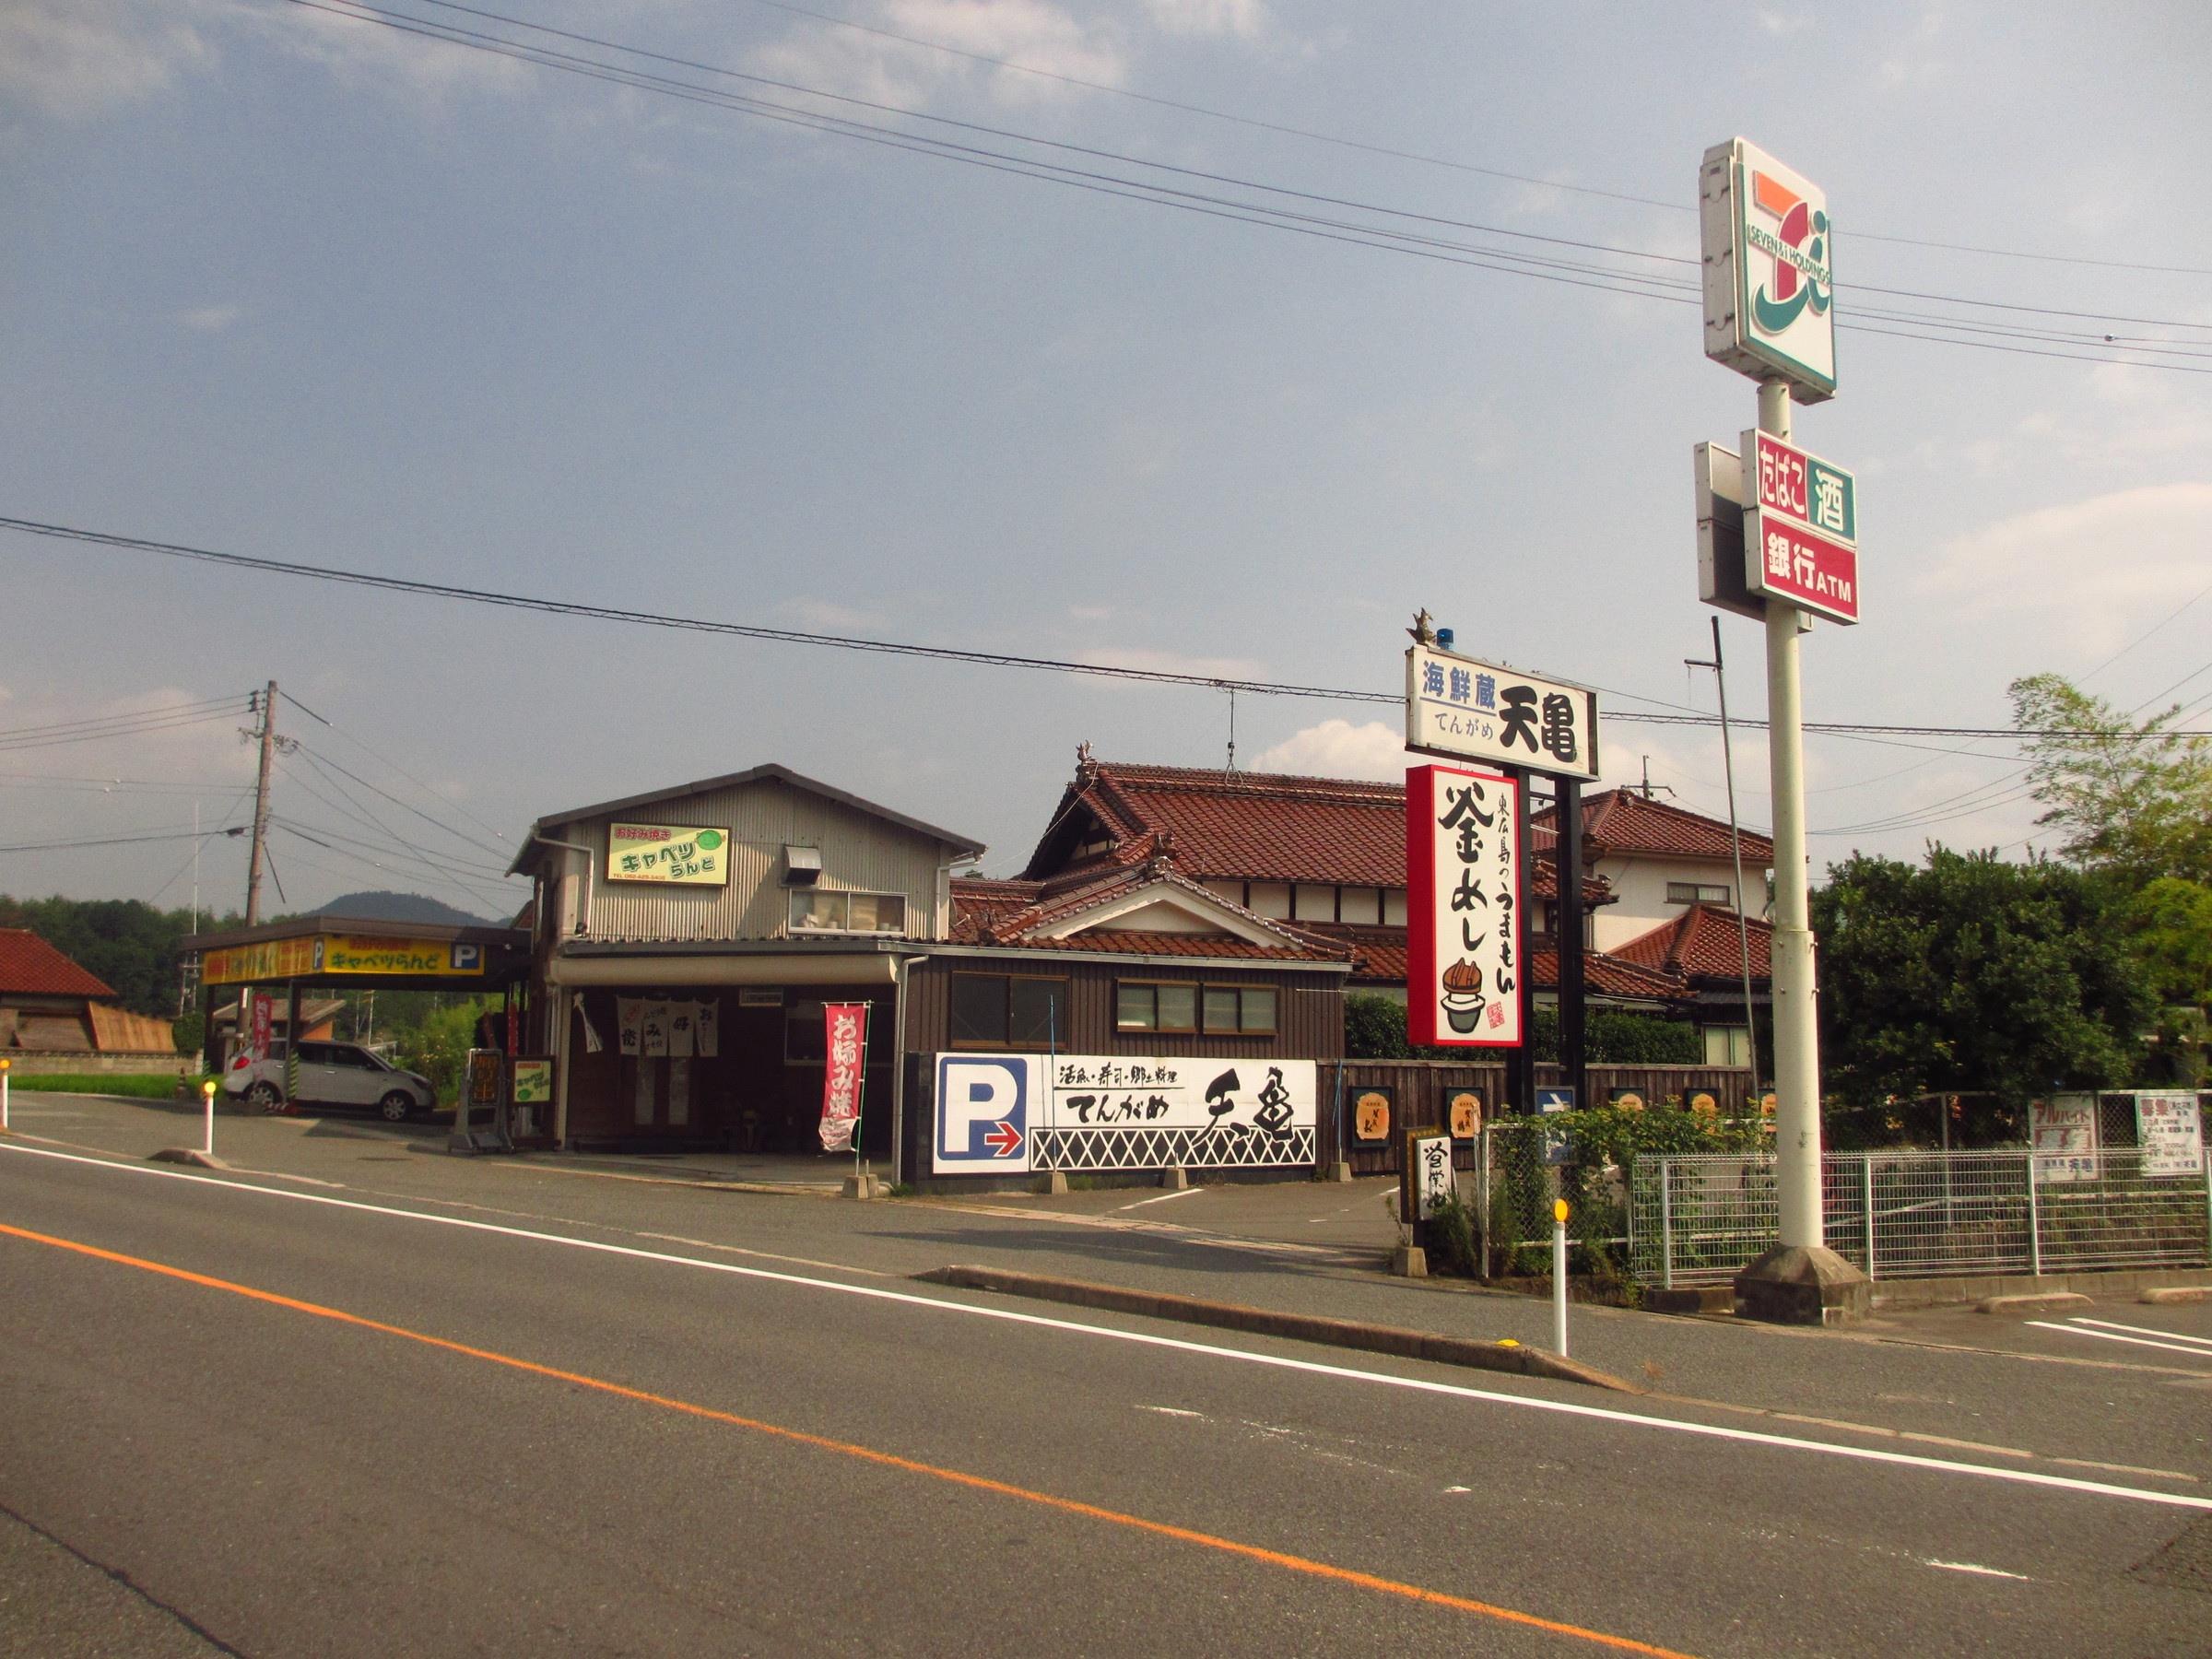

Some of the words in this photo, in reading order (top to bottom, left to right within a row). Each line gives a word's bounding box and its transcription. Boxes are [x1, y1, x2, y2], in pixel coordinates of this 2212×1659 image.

[1789, 247, 1830, 285] HOLDINGS
[1759, 444, 1806, 515] たばこ
[1815, 468, 1843, 532] 酒
[1422, 660, 1496, 710] 海鮮蔵
[1434, 712, 1494, 741] てんがめ
[1499, 685, 1577, 763] 天亀
[615, 826, 672, 841] お好み焼き
[620, 841, 696, 872] キャベツ
[671, 856, 716, 878] らんど
[1437, 781, 1494, 952] 釜めし
[1495, 791, 1516, 994] 東広島のうまもん
[313, 940, 324, 967] P
[331, 951, 441, 970] キャベツらんど
[453, 944, 477, 969] P
[945, 1064, 1018, 1153] P
[1065, 1094, 1171, 1124] てんがめ
[1191, 1065, 1294, 1146] 天亀
